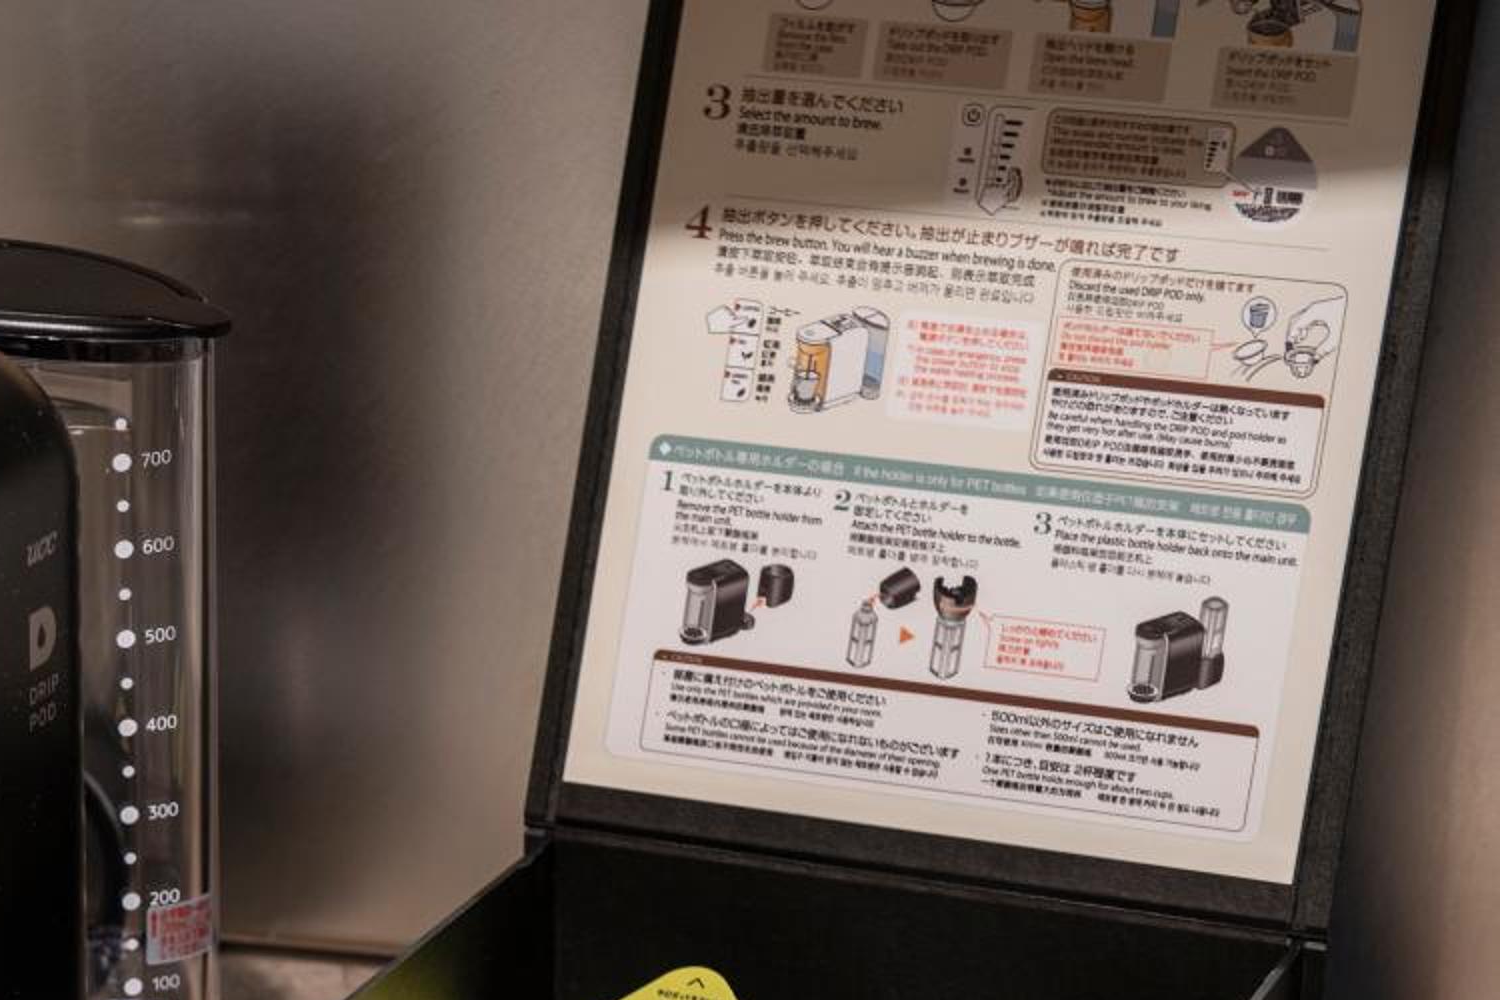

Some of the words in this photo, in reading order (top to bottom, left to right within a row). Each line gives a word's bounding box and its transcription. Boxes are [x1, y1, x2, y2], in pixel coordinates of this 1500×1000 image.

[705, 85, 730, 119] 3
[685, 204, 714, 240] 4
[746, 231, 763, 244] the
[832, 238, 851, 252] You
[140, 449, 172, 469] 700
[660, 470, 673, 492] 1
[834, 490, 850, 512] 2
[1034, 513, 1052, 535] 3
[143, 536, 175, 555] 600
[145, 626, 176, 644] 500
[146, 715, 177, 733] 400
[148, 802, 179, 820] 300
[150, 888, 180, 905] 200
[152, 974, 180, 990] 100
